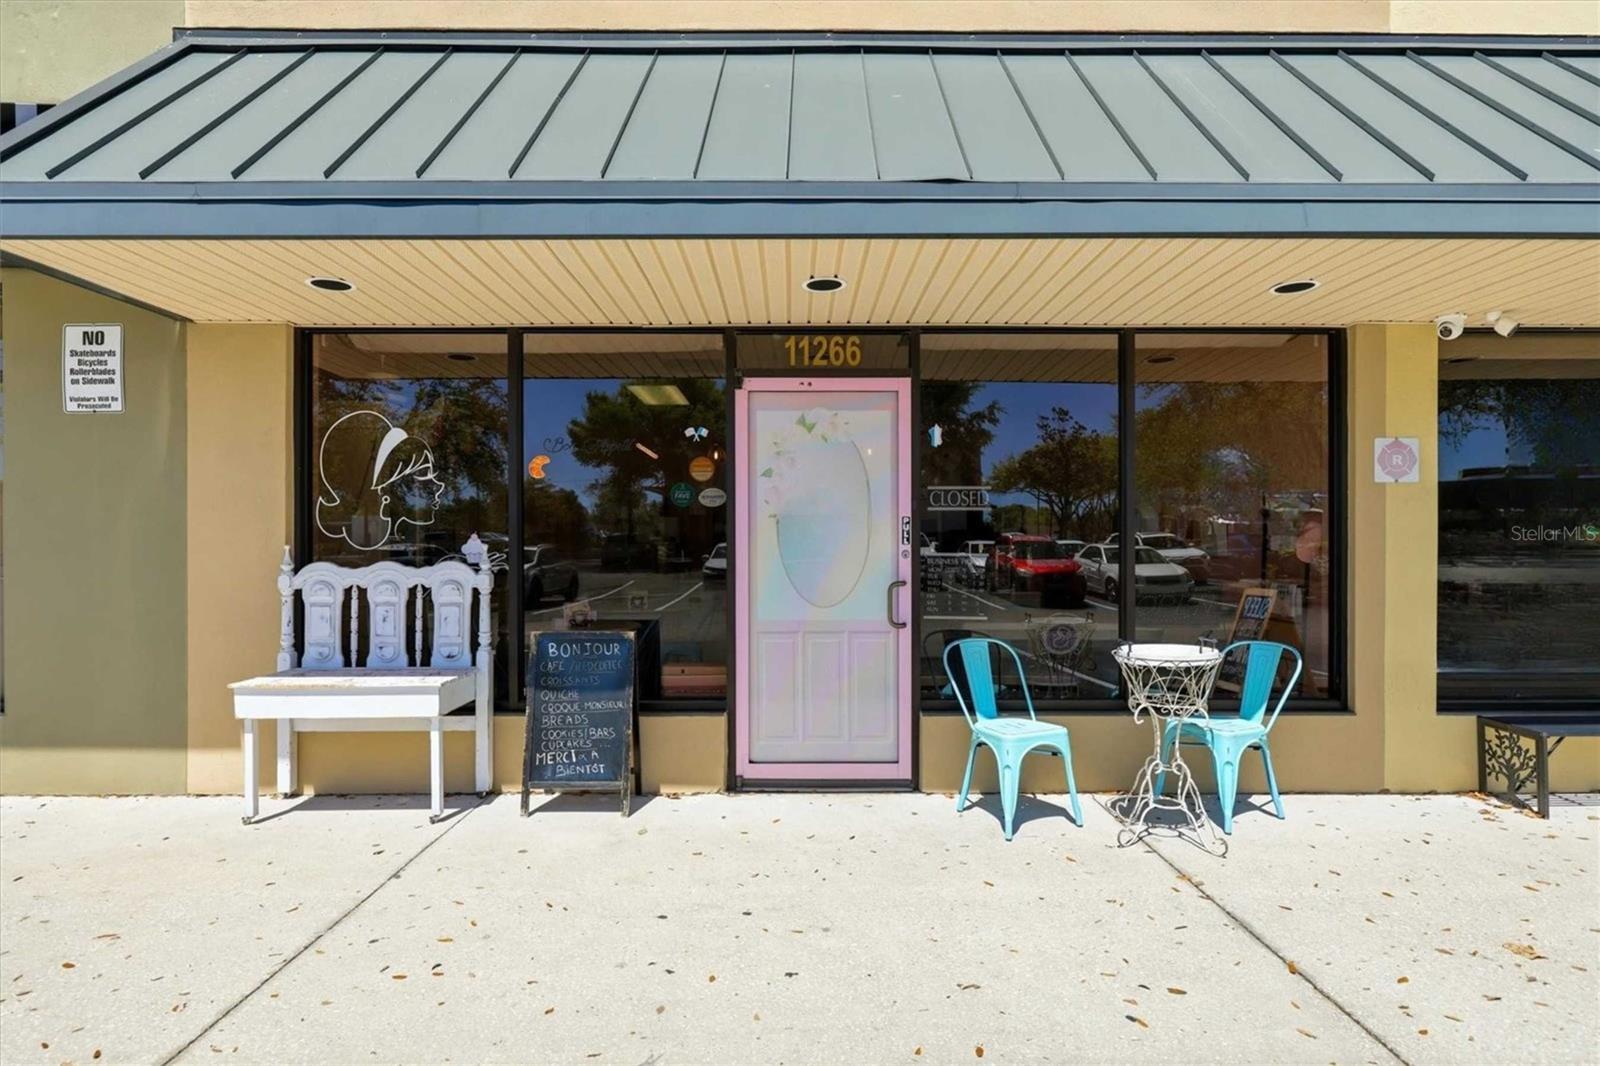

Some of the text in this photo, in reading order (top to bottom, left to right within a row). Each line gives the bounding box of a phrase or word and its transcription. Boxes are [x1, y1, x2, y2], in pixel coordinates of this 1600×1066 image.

[82, 330, 105, 346] NO
[69, 349, 117, 358] Skateboards
[784, 335, 862, 367] 11266
[77, 359, 108, 367] Bicycles
[69, 368, 116, 376] Rollerblades
[81, 377, 115, 385] Sidewalk
[929, 490, 990, 507] CLOSED
[547, 642, 621, 658] BONJOUR
[540, 690, 580, 701] QUICHE
[541, 703, 580, 714] CROQUE
[542, 714, 589, 728] BREADS
[541, 740, 593, 752] CUPCAKES
[535, 749, 577, 766] MERCI
